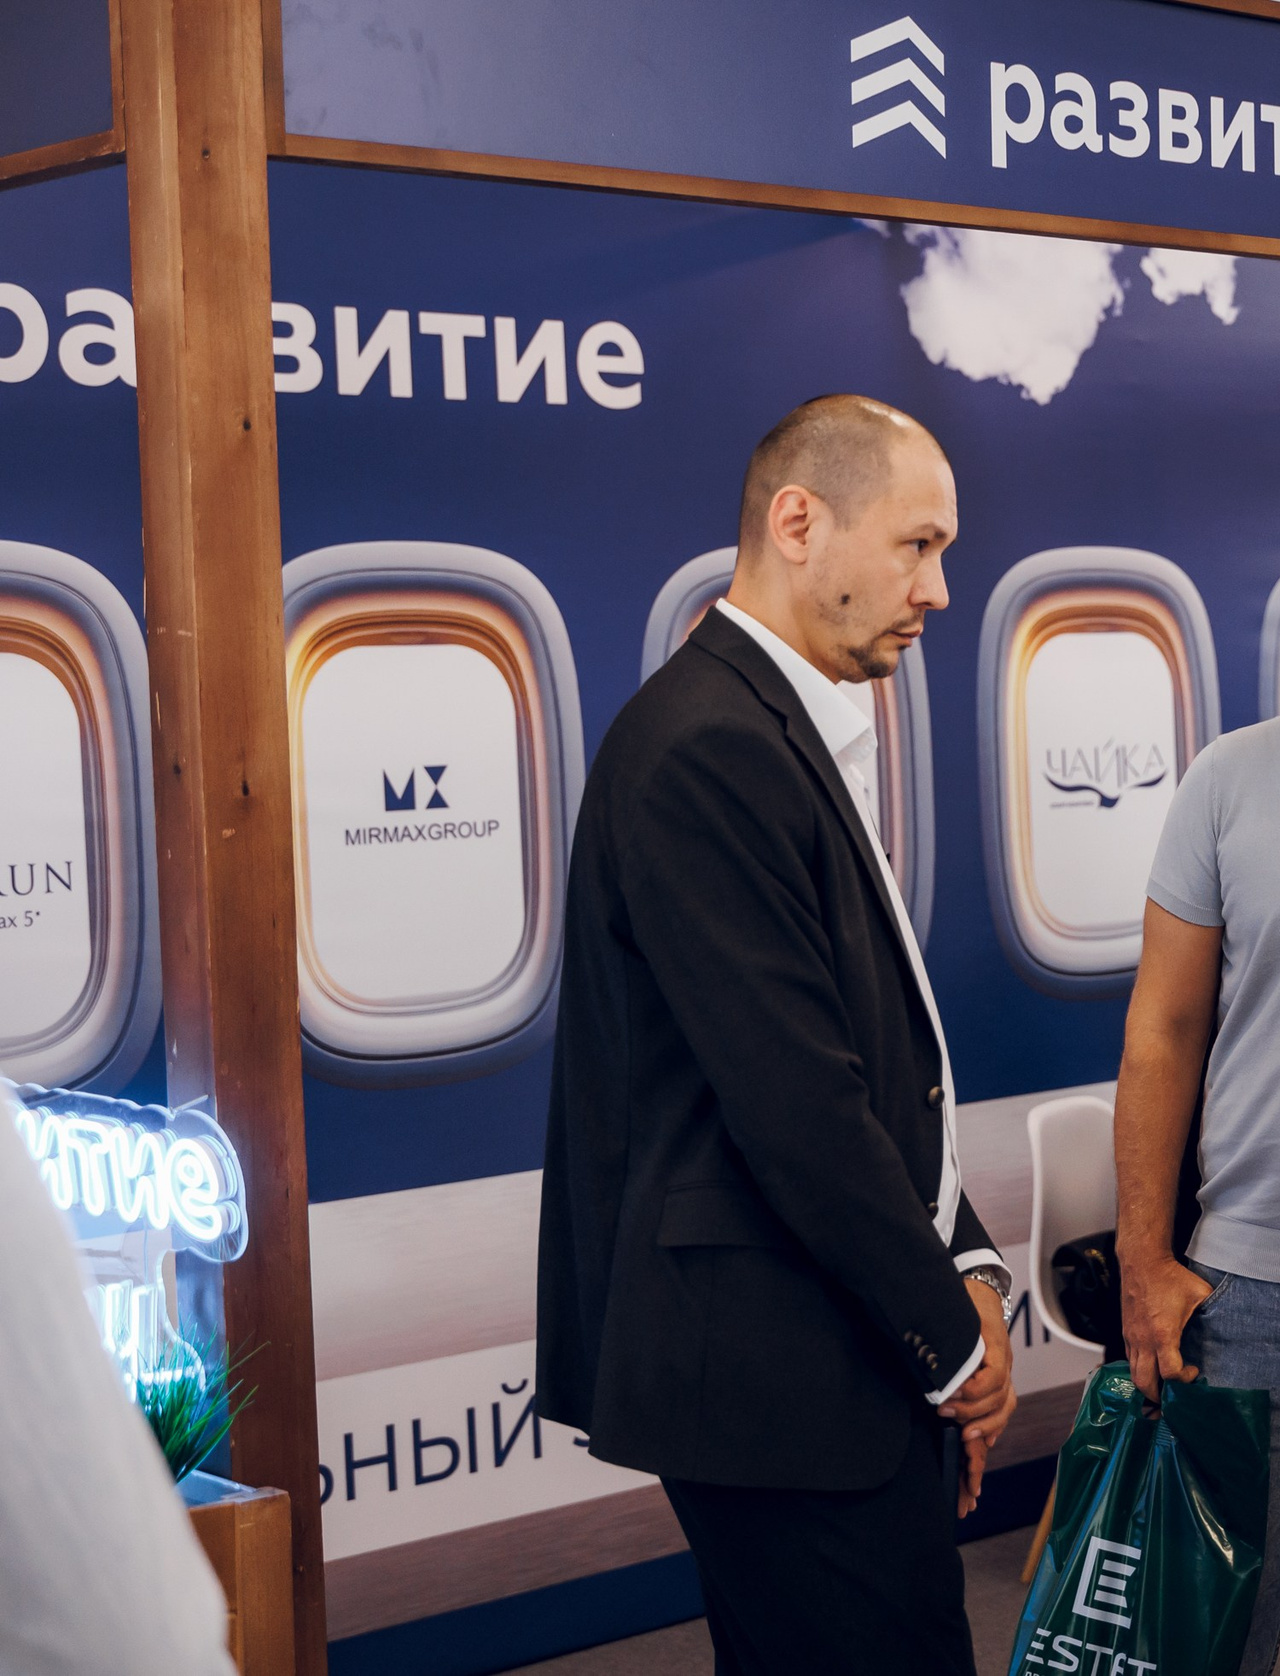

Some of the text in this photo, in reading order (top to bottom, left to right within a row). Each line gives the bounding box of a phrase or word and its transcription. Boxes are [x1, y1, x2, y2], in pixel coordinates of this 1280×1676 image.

[0, 282, 645, 410] авитие
[1046, 737, 1166, 788] ЧАЙКА
[345, 820, 500, 847] MIRMAXGROUP
[0, 861, 73, 897] UN
